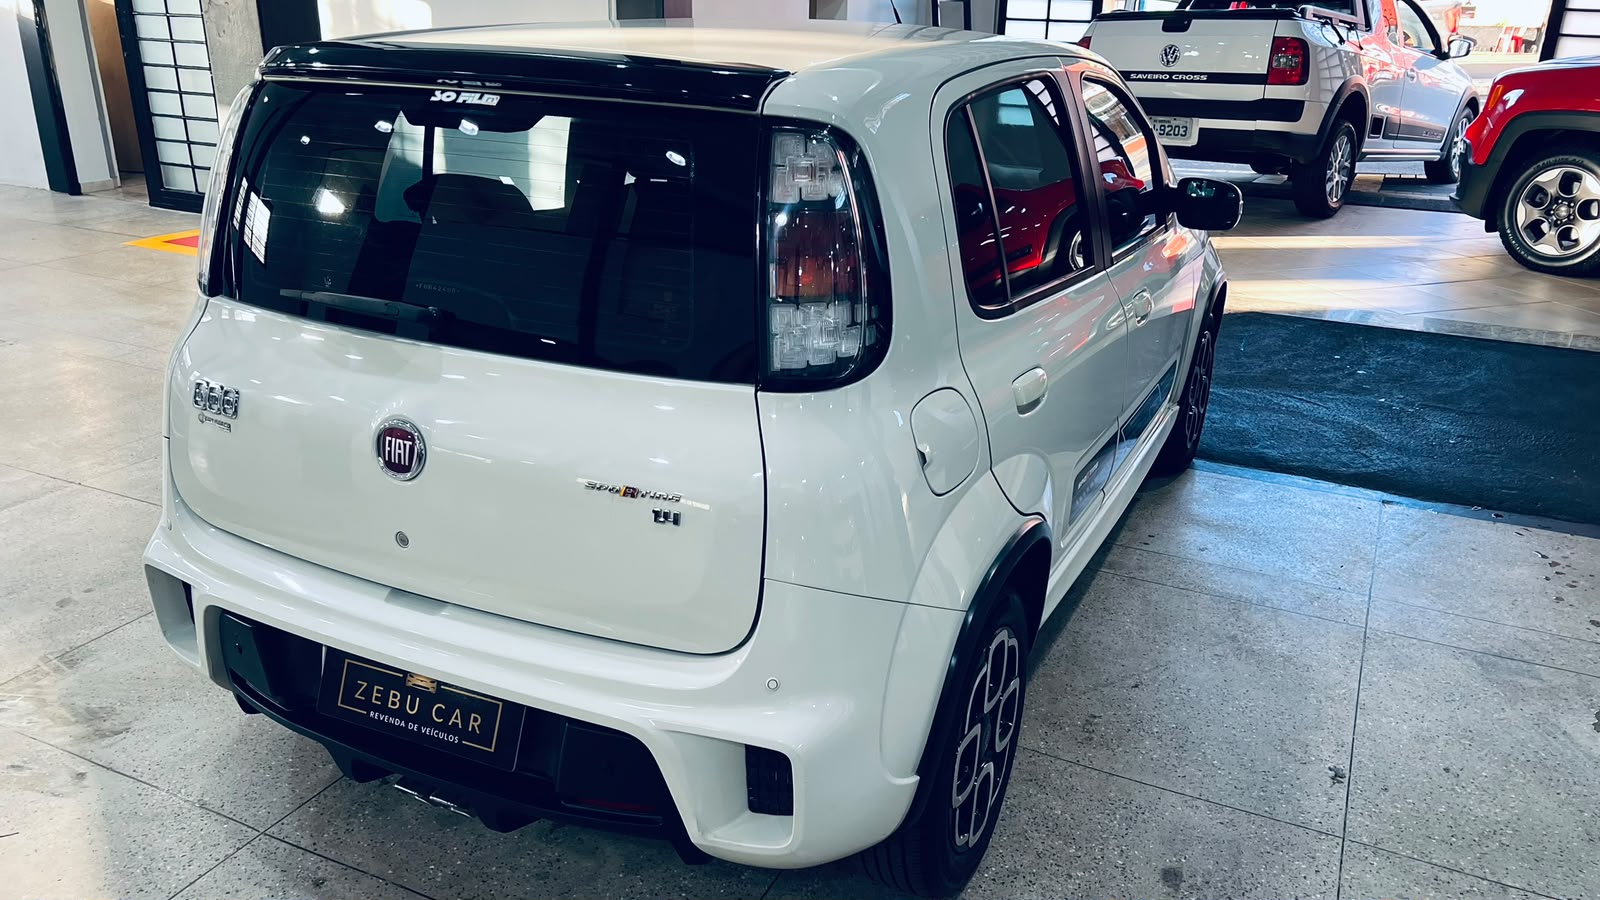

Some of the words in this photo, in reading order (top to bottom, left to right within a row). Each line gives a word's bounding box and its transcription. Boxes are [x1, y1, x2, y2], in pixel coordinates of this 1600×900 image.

[385, 435, 413, 466] FIAT
[354, 680, 420, 715] ZEBU
[431, 703, 482, 734] CAR
[369, 711, 406, 728] REVENDA
[407, 722, 419, 732] DE
[421, 726, 459, 744] VEÍCULOS
